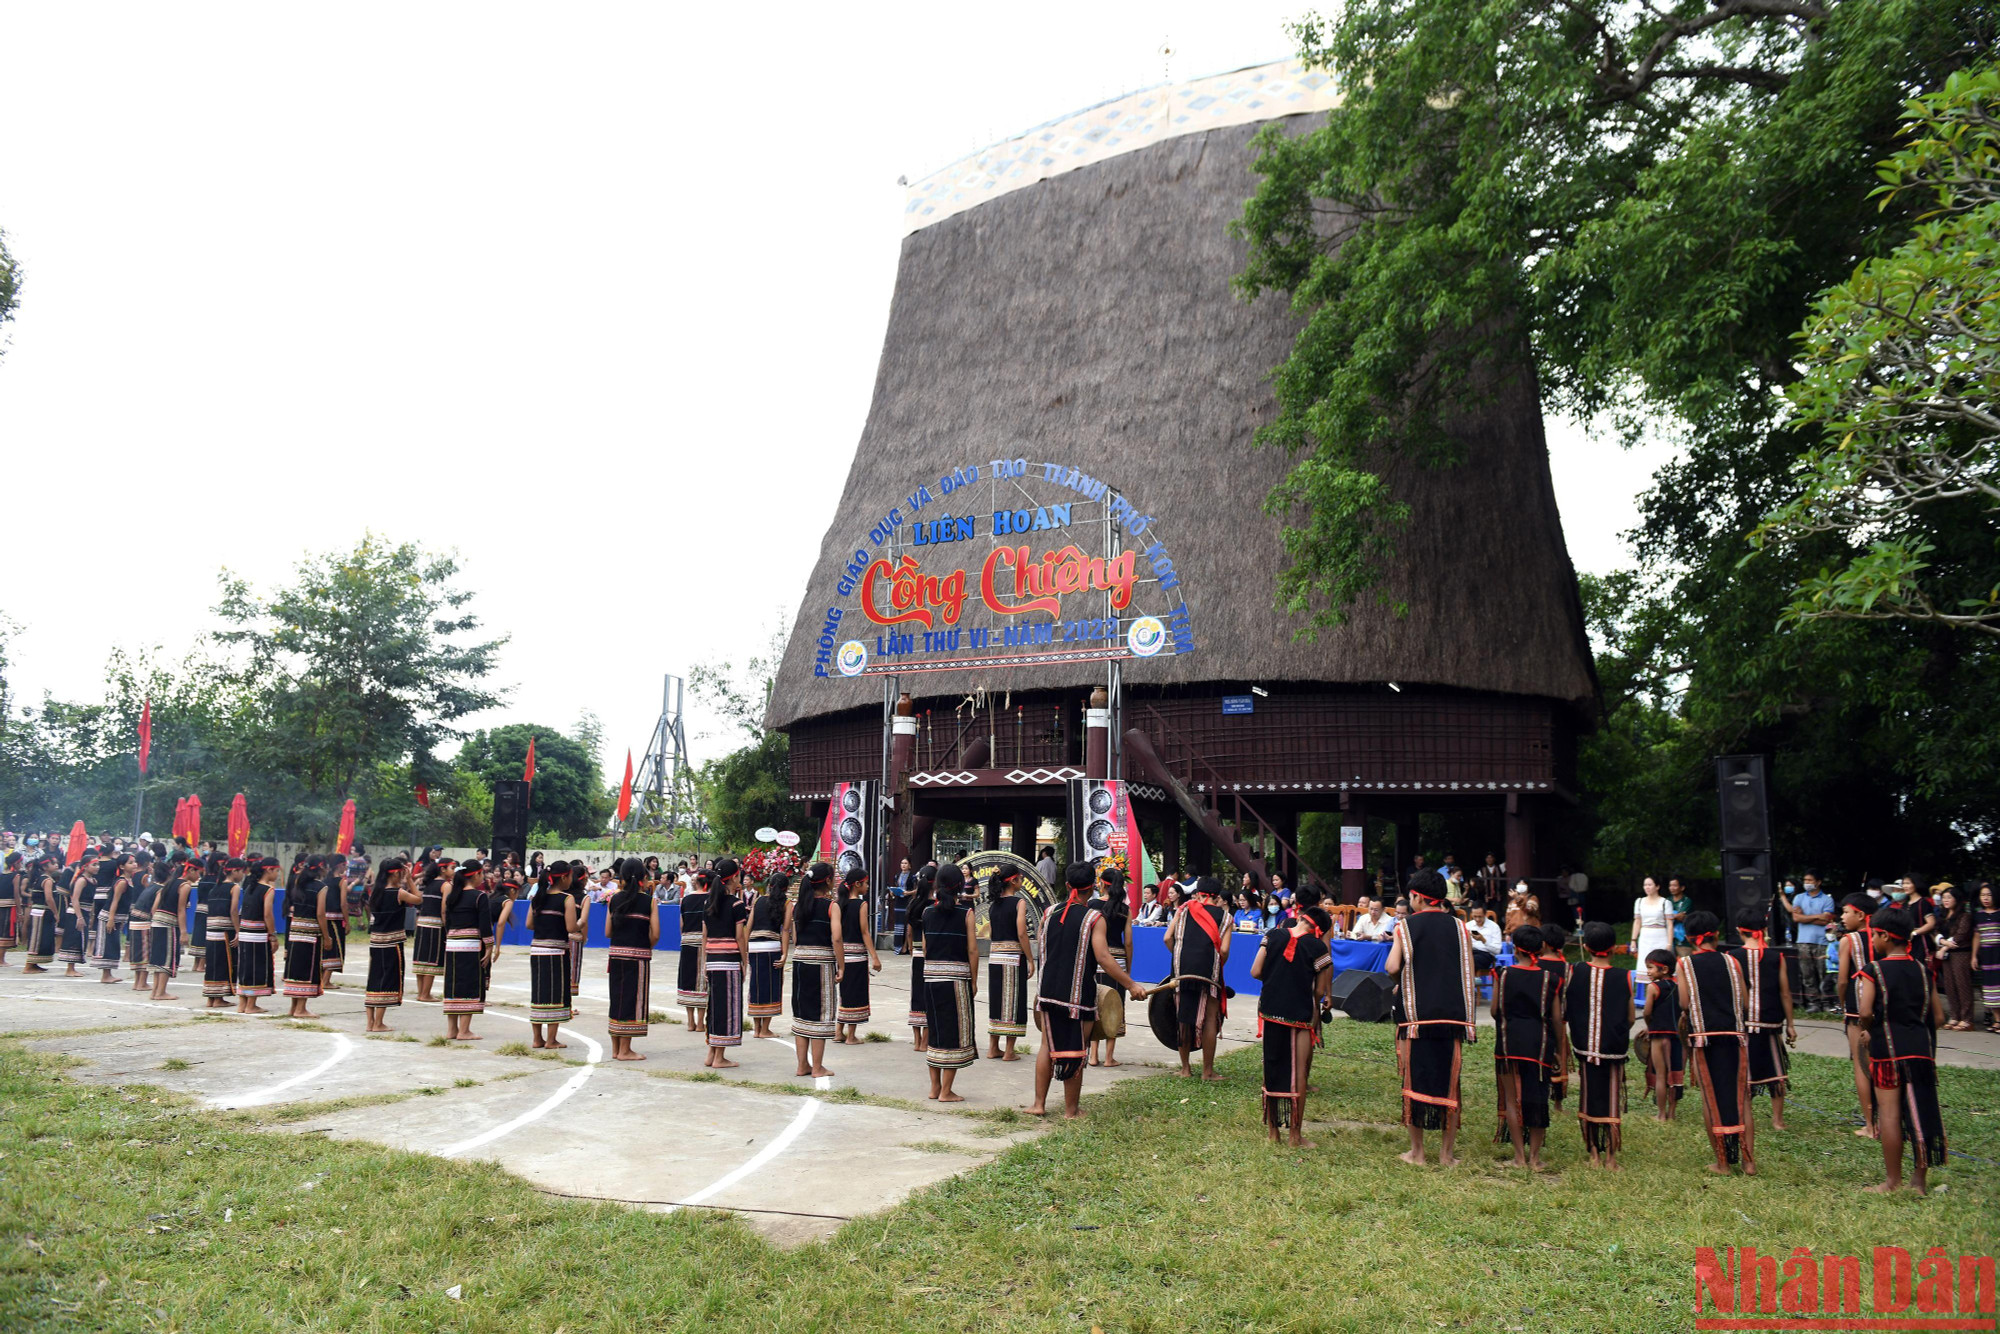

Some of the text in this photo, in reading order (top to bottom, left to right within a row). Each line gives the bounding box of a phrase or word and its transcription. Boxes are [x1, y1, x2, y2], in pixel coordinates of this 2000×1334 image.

[912, 502, 1073, 547] LIÊN HOAN
[814, 606, 843, 678] PHÒNG
[837, 549, 870, 597] GIÁO
[869, 507, 904, 548] DỤC
[907, 484, 933, 512] VÀ
[940, 465, 979, 495] ĐÀO
[989, 458, 1027, 482] TẠO
[1043, 462, 1108, 503] THÀNH
[1109, 495, 1157, 537] PHỐ
[1145, 541, 1180, 591] KON
[1168, 601, 1195, 655] TUM
[861, 545, 1139, 631] Cồng Chiêng
[877, 626, 914, 657] LẦN
[923, 622, 962, 653] THỨ
[1062, 617, 1119, 643] 2022
